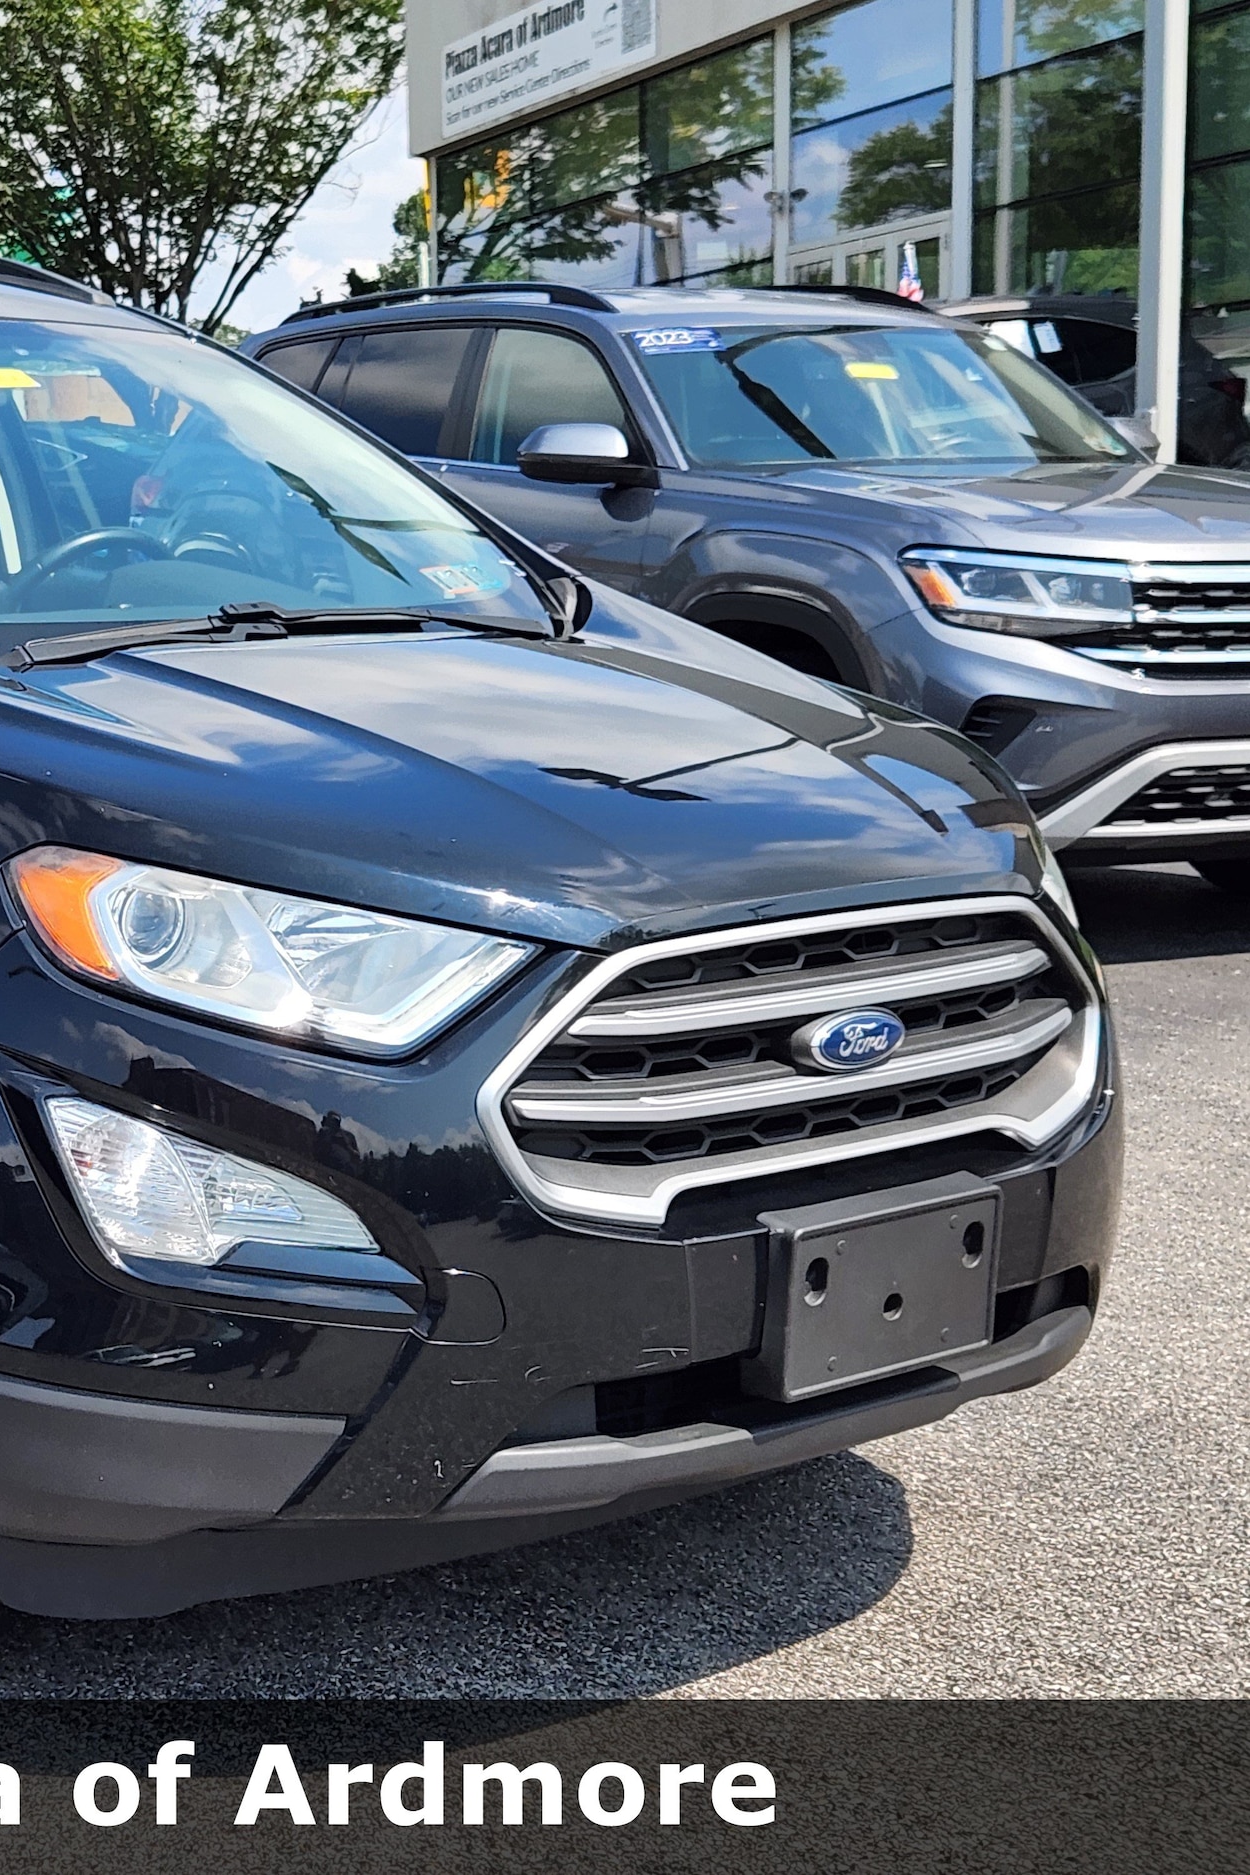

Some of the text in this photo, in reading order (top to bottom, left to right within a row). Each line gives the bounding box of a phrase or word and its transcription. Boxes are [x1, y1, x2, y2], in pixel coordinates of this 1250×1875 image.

[480, 28, 513, 65] Acura
[516, 16, 528, 49] of
[530, 0, 585, 43] Ardmore
[634, 330, 694, 348] 2023
[838, 1021, 890, 1058] Ford
